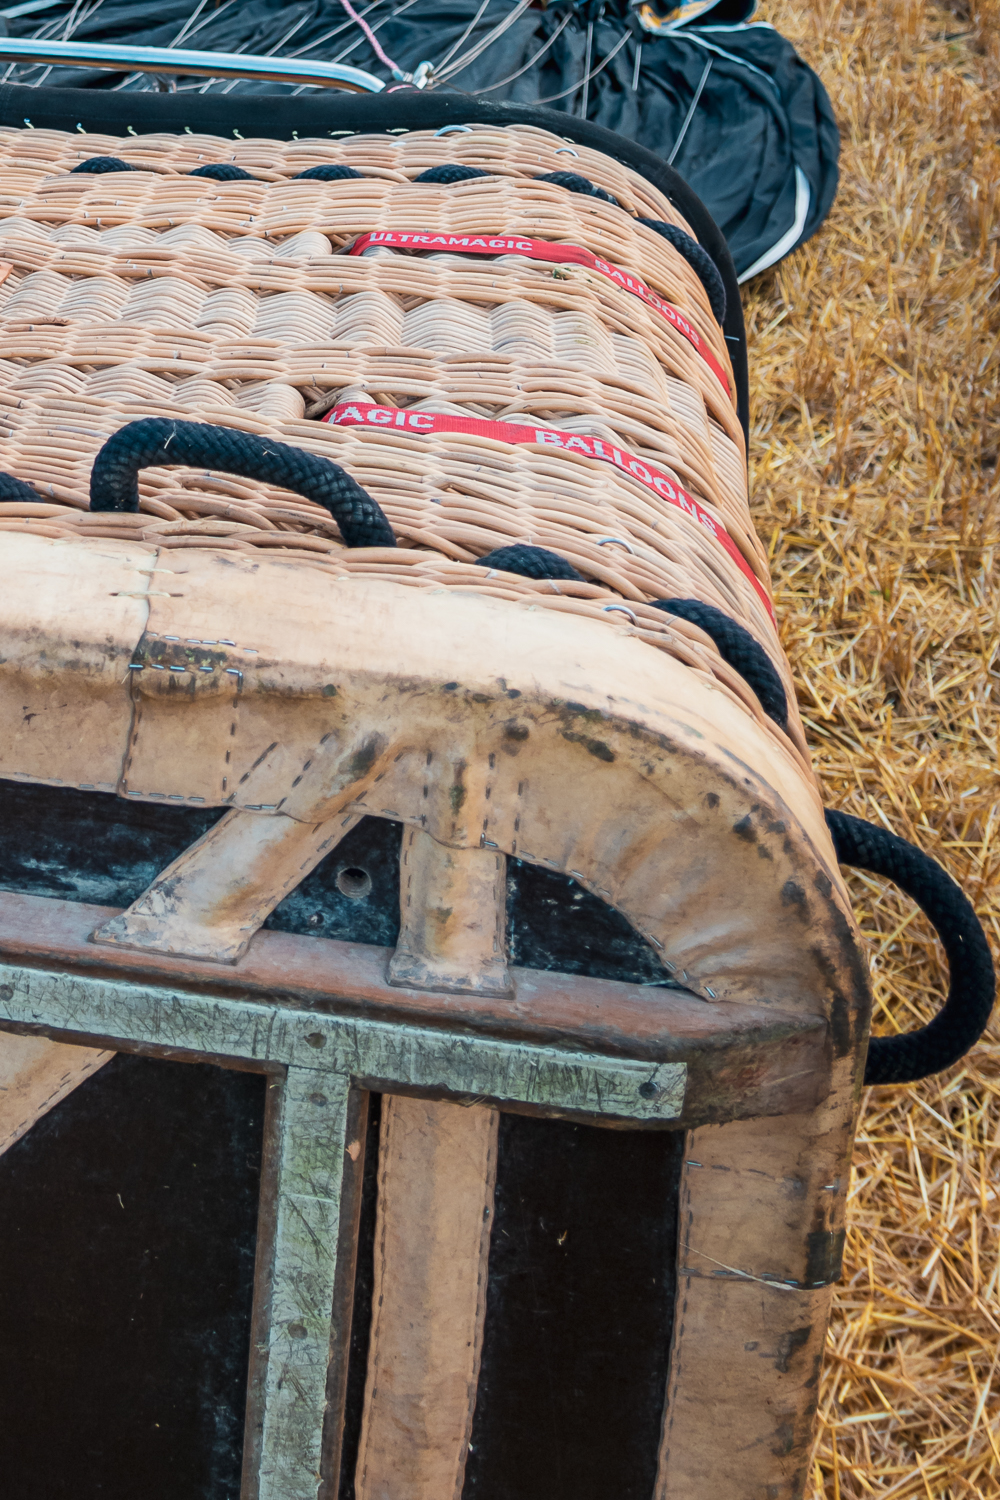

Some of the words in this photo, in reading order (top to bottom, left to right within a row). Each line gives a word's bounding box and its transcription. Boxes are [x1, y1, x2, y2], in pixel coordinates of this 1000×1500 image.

[369, 232, 533, 251] ULTRAMAGIC
[595, 259, 700, 346] BALLOONS
[328, 406, 435, 429] AGIC
[535, 430, 718, 537] BALLOONS
